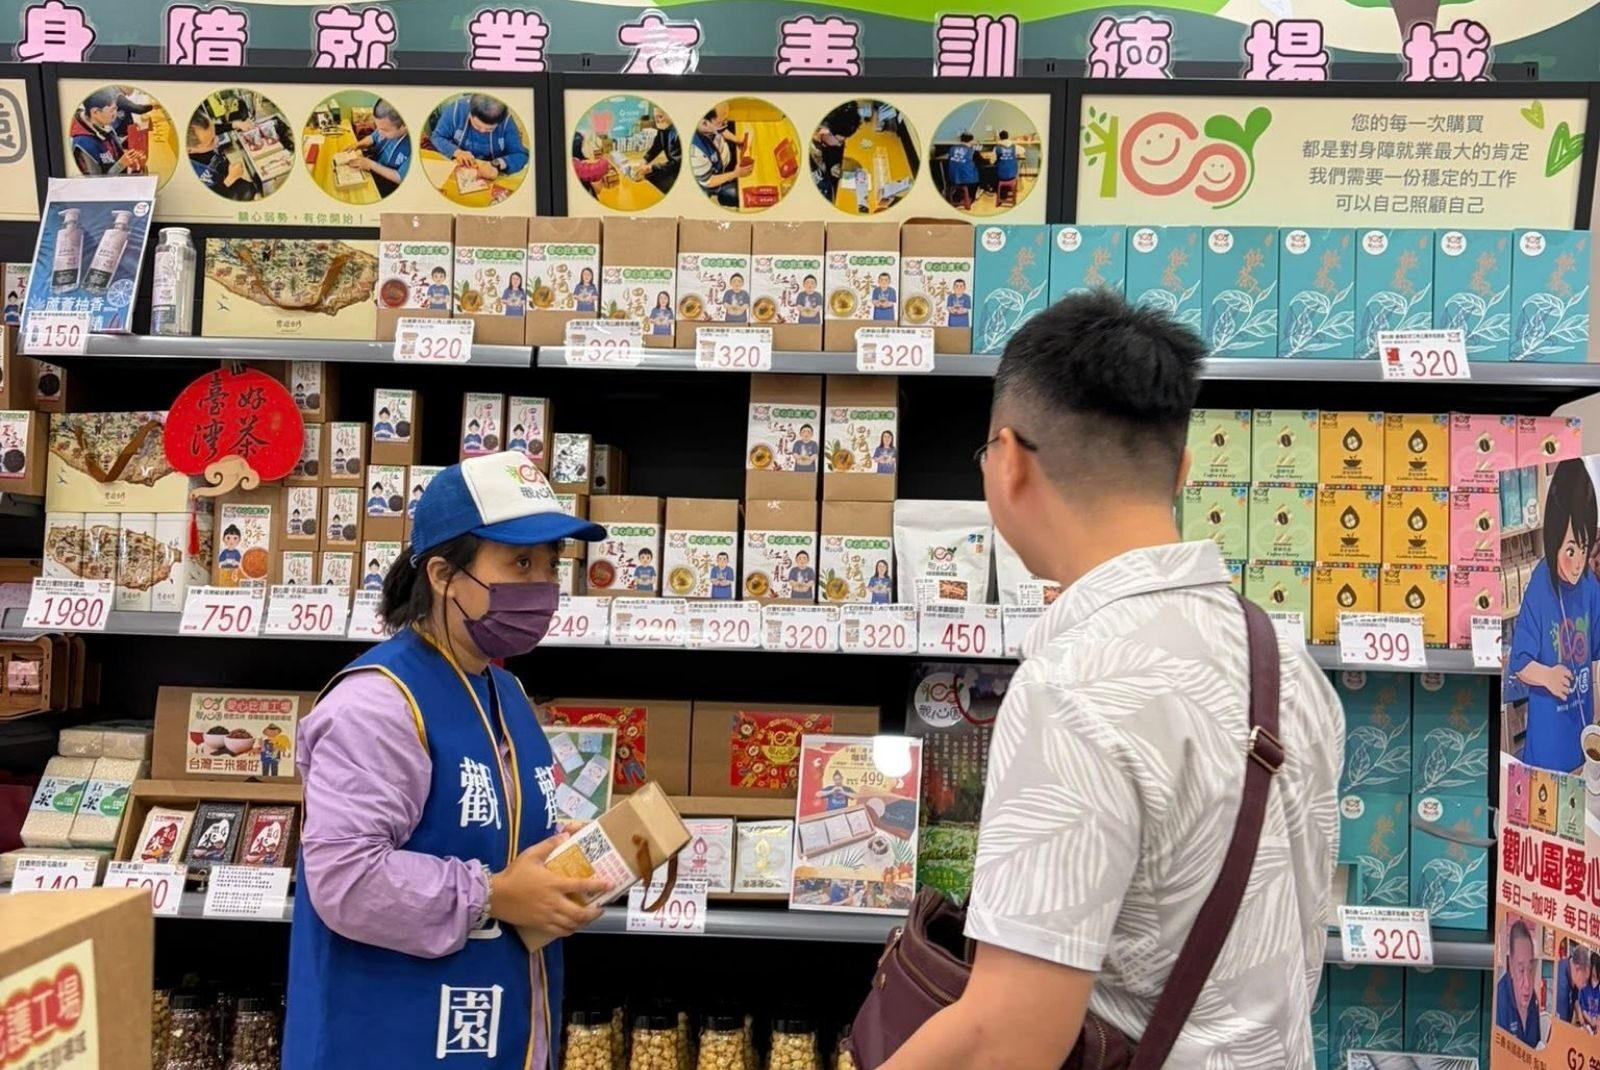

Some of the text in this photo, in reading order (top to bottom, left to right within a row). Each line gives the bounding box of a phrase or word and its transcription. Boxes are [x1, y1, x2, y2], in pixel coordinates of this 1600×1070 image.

[1351, 113, 1484, 133] 您的每一次購買
[1302, 140, 1530, 161] 都是對身障就業最大的肯定
[1309, 167, 1517, 188] 我們需要一份穩定的工作
[1336, 194, 1485, 214] 可以自己照顧自己
[44, 325, 80, 347] 150
[419, 337, 461, 359] 320
[589, 339, 630, 361] 320
[718, 346, 760, 367] 320
[881, 345, 923, 366] 320
[1410, 350, 1457, 376] 320
[226, 387, 270, 458] 好茶
[38, 597, 104, 627] 1980
[201, 605, 252, 632] 750
[288, 604, 333, 630] 350
[634, 618, 677, 641] 320
[708, 620, 750, 643] 320
[785, 625, 827, 649] 320
[863, 624, 905, 648] 320
[942, 623, 986, 653] 450
[1363, 632, 1410, 661] 399
[860, 772, 884, 786] 499
[1502, 827, 1600, 907] 觀心園愛心
[1502, 880, 1557, 921] 每日一咖啡
[1374, 928, 1420, 960] 320
